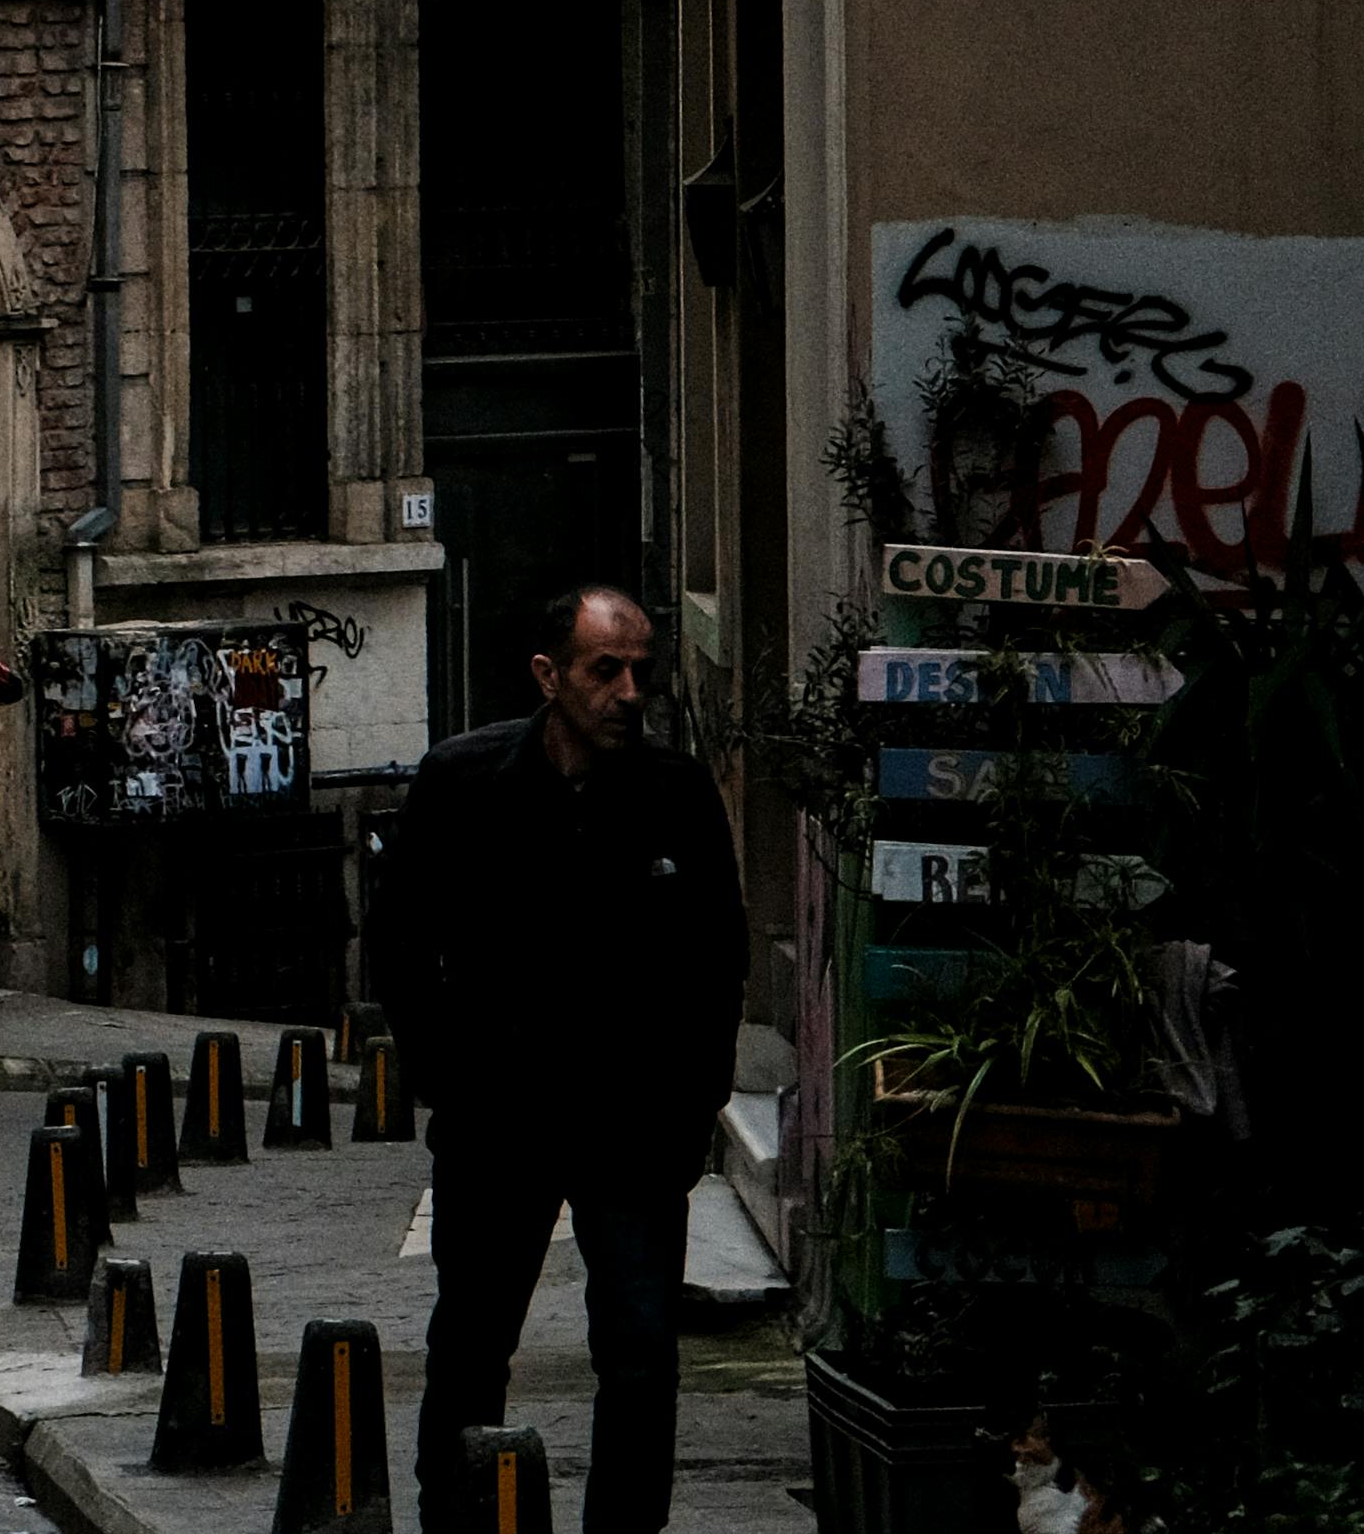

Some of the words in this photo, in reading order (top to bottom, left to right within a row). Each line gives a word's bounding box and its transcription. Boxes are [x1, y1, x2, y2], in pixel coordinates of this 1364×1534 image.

[407, 499, 427, 519] 15
[889, 551, 1120, 605] COSTUME
[885, 660, 1071, 703] DESN
